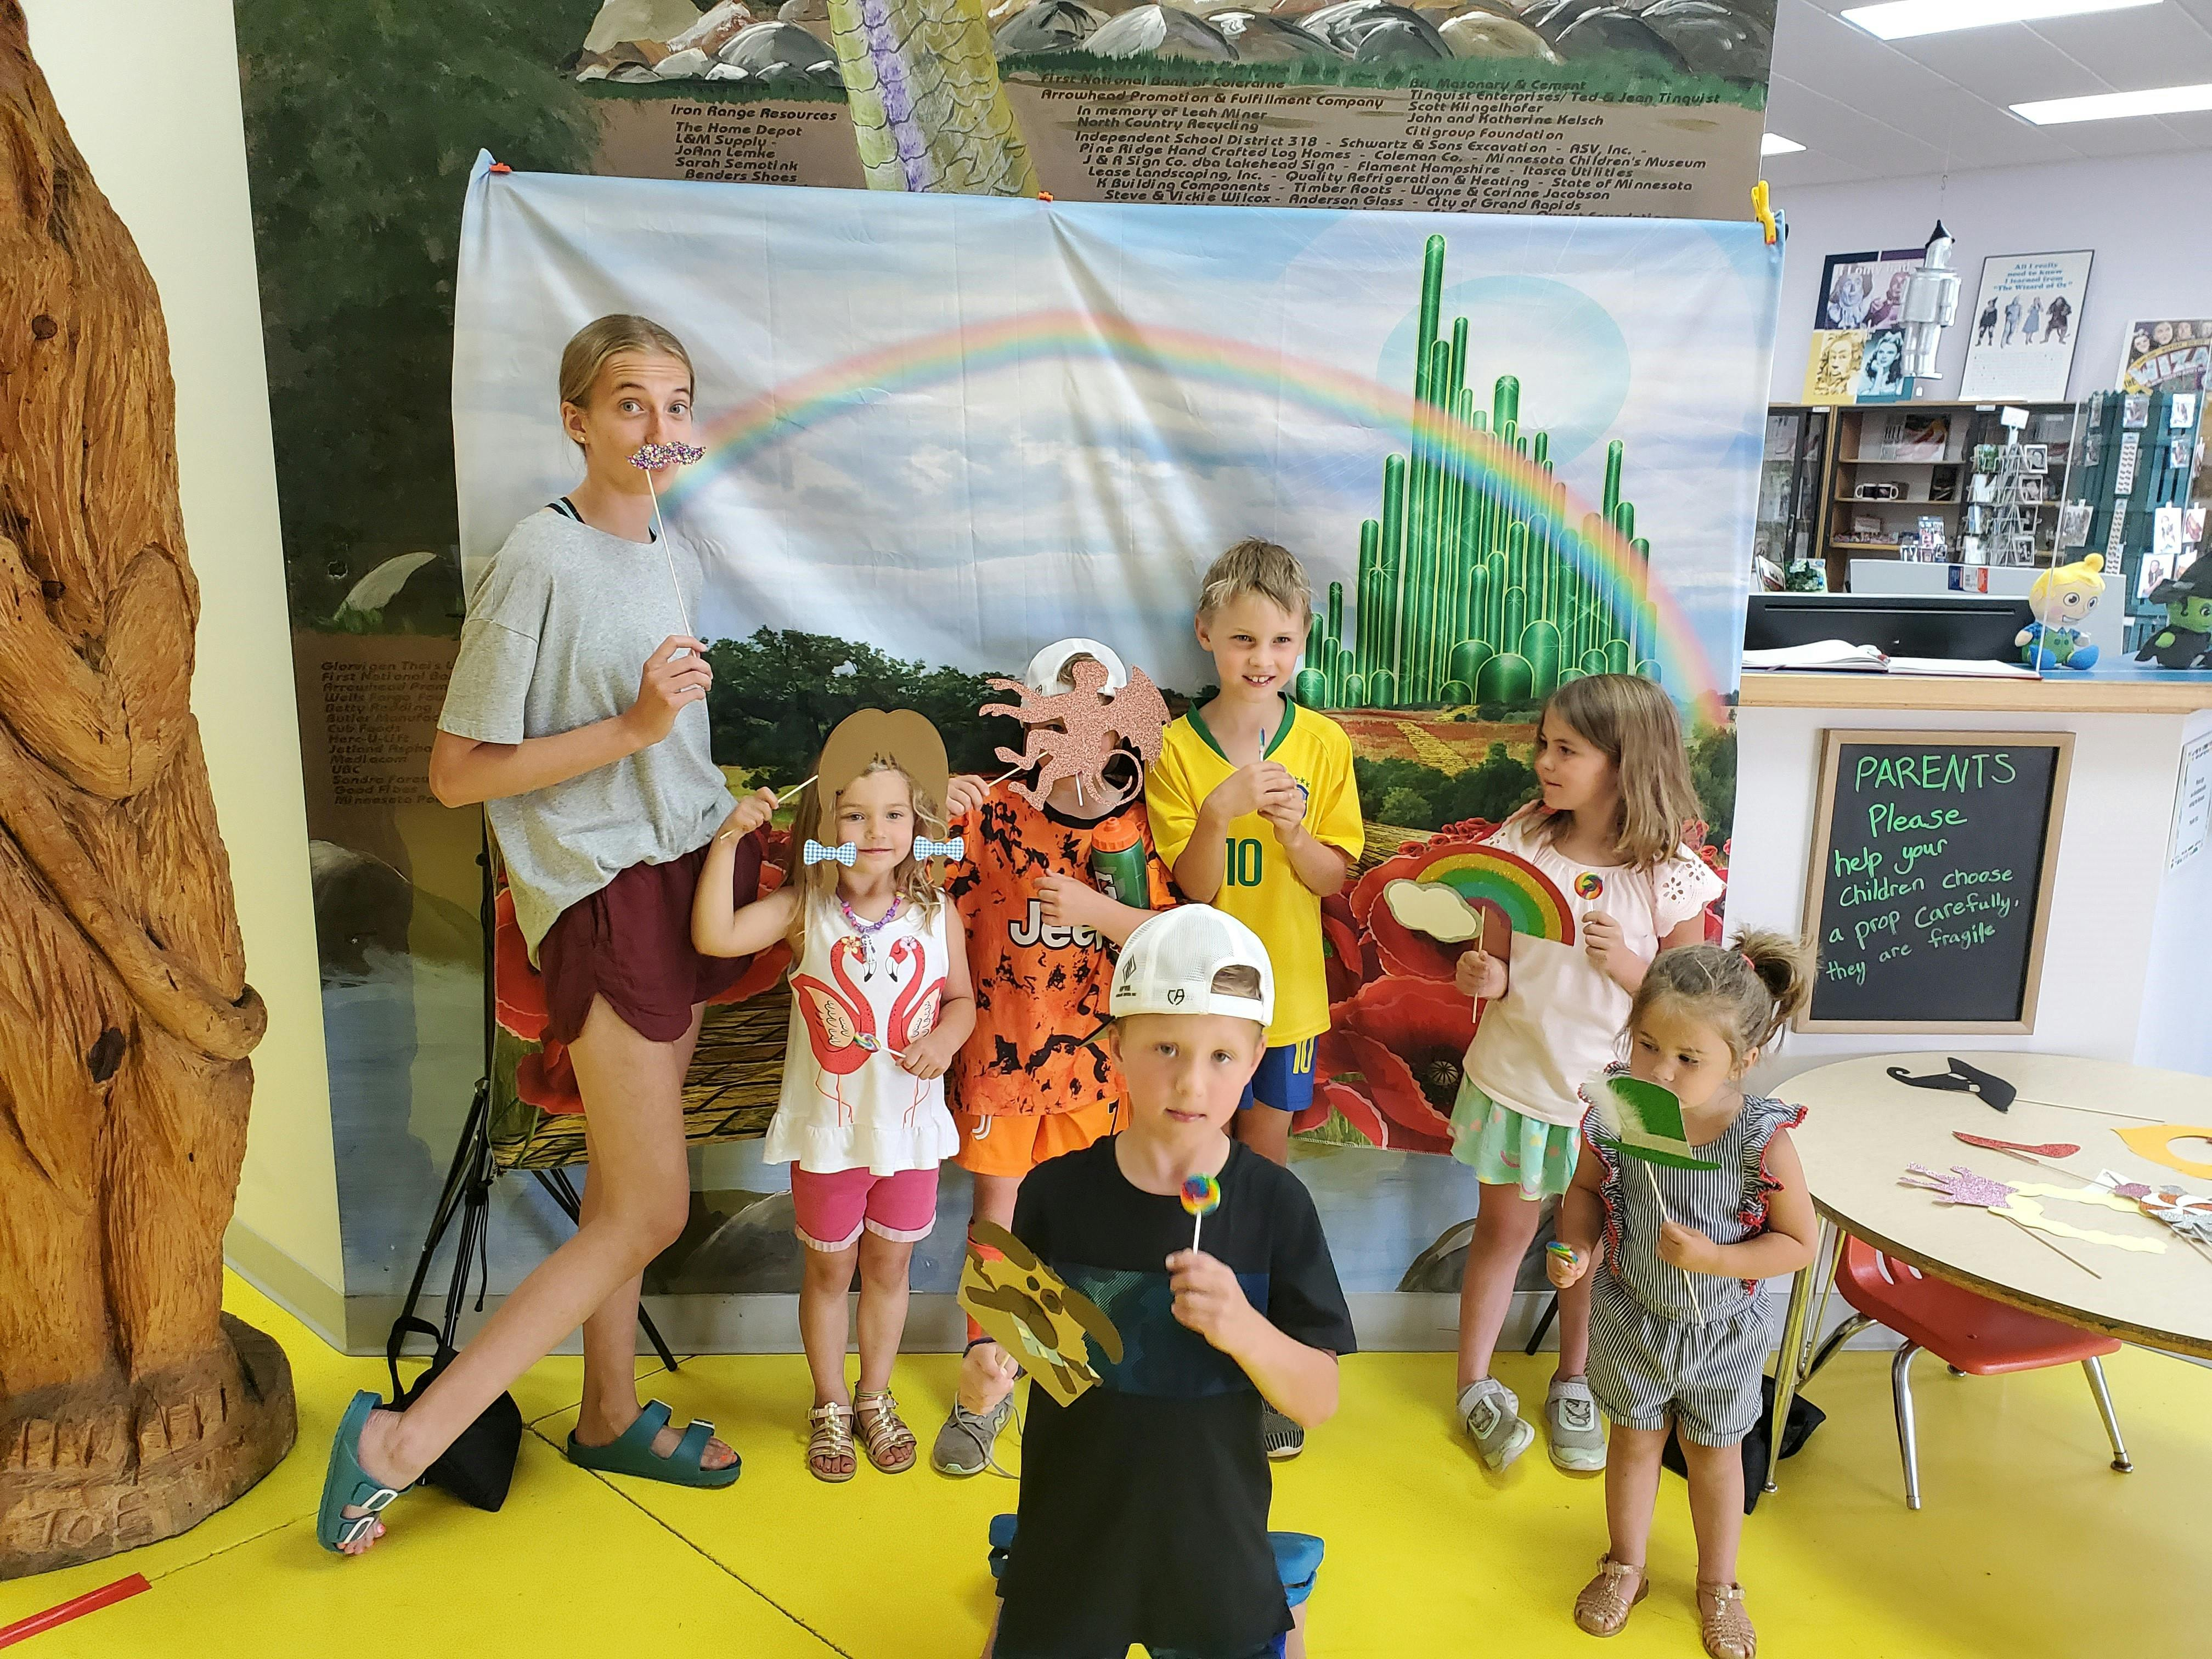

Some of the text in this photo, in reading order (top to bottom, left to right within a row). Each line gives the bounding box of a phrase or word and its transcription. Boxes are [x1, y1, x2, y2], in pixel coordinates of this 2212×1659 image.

[1041, 73, 1077, 84] First
[1079, 74, 1148, 86] National
[1151, 75, 1188, 86] Bank
[1192, 76, 1207, 87] of
[1516, 79, 1527, 89] &
[1530, 80, 1587, 90] Cement
[1040, 88, 1384, 109] Arrowhead Promotion & Fulfillment Company
[1408, 100, 1445, 111] Scott
[1410, 89, 1720, 106] Tinquist Enterprises/ Ted & Jean Tinquist
[670, 104, 837, 121] Iron Range Resources
[1076, 104, 1267, 119] In memory of Leah Miner
[1407, 112, 1604, 125] John and Katherine Kelsch
[675, 121, 803, 139] The Home Depot
[1077, 116, 1259, 133] North Country Recycling
[1404, 125, 1564, 140] Citigroup Foundation
[675, 144, 776, 158] JoAnn Lemke
[714, 134, 767, 149] Supply
[1074, 131, 1632, 157] Independent School District 318 Schwartz & Sons Excavation ASV, Inc.
[675, 156, 720, 168] Sarah
[1079, 142, 1706, 168] Pine Ridge Hand Crafted Log Homes Coleman Co. Minnesota Children's Museum
[685, 167, 798, 182] Benders Shoes
[1096, 154, 1108, 165] &
[1112, 154, 1122, 165] R
[1125, 155, 1162, 168] Sign
[1165, 156, 1187, 166] Co.
[1225, 157, 1295, 169] Lakehead
[1300, 159, 1335, 173] Sign
[1420, 162, 1500, 177] Hampshire
[1522, 165, 1566, 176] Itasca
[1571, 166, 1634, 178] Utilities
[1088, 165, 1692, 190] Lease Landscaping, Inc. Quality Refrigeration & Heating State of Minnesota
[1111, 177, 1176, 192] Building
[1180, 179, 1271, 194] Components
[1293, 182, 1346, 193] Timber
[1350, 183, 1392, 194] Roots
[1410, 184, 1462, 199] Wayne
[1466, 186, 1479, 196] &
[1482, 187, 1540, 198] Corinne
[1543, 188, 1610, 199] Jacobson
[1104, 189, 1148, 200] Steve
[1153, 190, 1166, 200] &
[1168, 190, 1216, 201] Vickie
[1221, 191, 1272, 203] Wilcox
[1288, 193, 1359, 205] Anderson
[1363, 195, 1404, 206] Glass
[1426, 196, 1458, 210] City
[1461, 197, 1477, 207] of
[1481, 198, 1527, 208] Grand
[1531, 199, 1581, 213] Rapids
[1855, 753, 2016, 793] PARENTS
[1869, 803, 1968, 838] Please
[1226, 838, 1263, 888] 10
[1835, 838, 1948, 877] help your
[1008, 898, 1103, 953] Jee
[1828, 927, 1844, 944] a
[1854, 910, 1900, 950] prop
[1825, 922, 1996, 986] they are fragile
